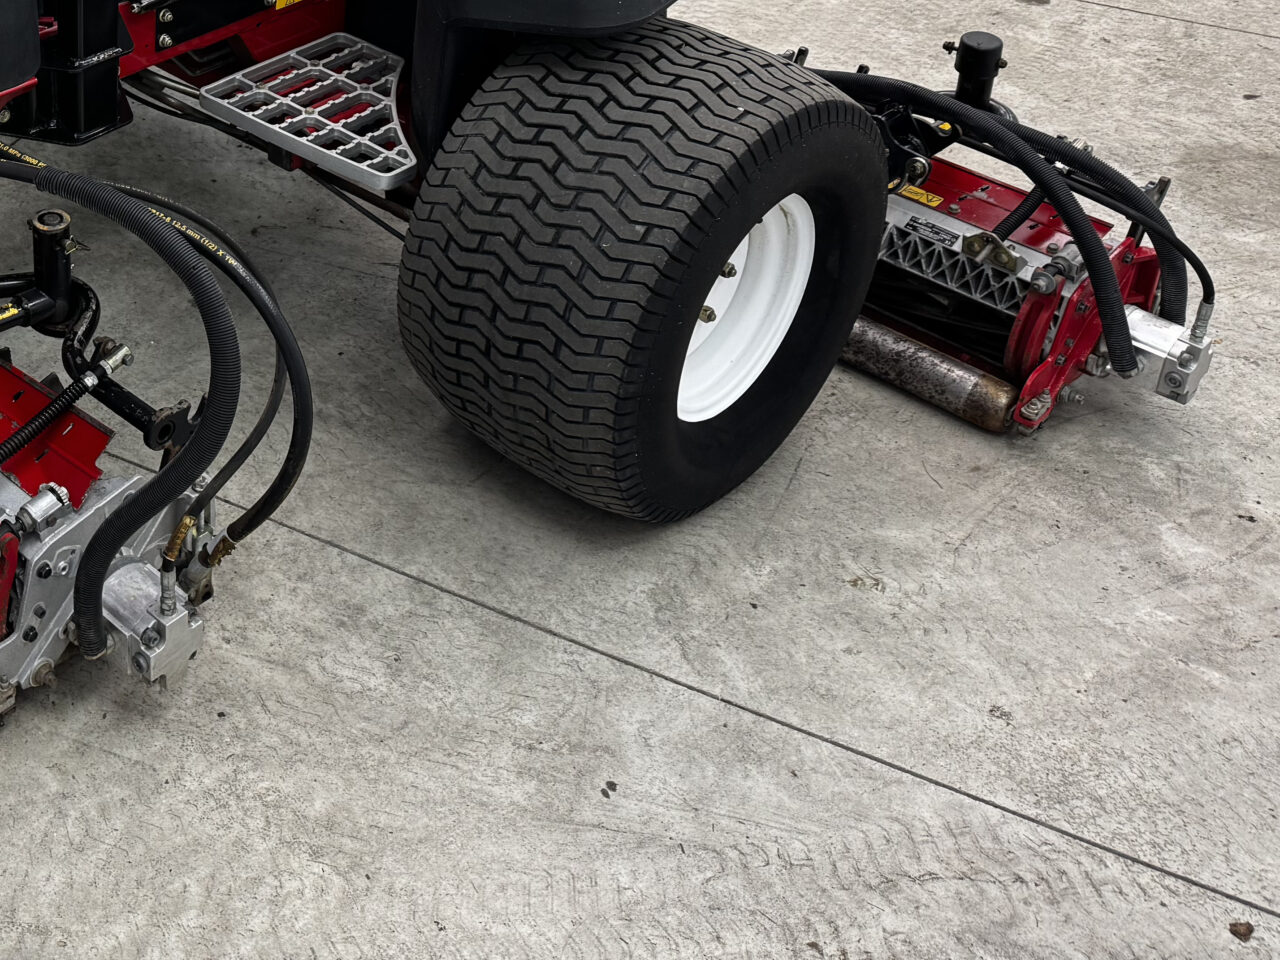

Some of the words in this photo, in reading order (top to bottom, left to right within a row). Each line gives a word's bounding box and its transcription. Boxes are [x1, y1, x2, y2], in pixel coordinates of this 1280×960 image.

[172, 220, 188, 231] 12.5
[186, 229, 201, 240] mm
[200, 237, 218, 251] (1/2)
